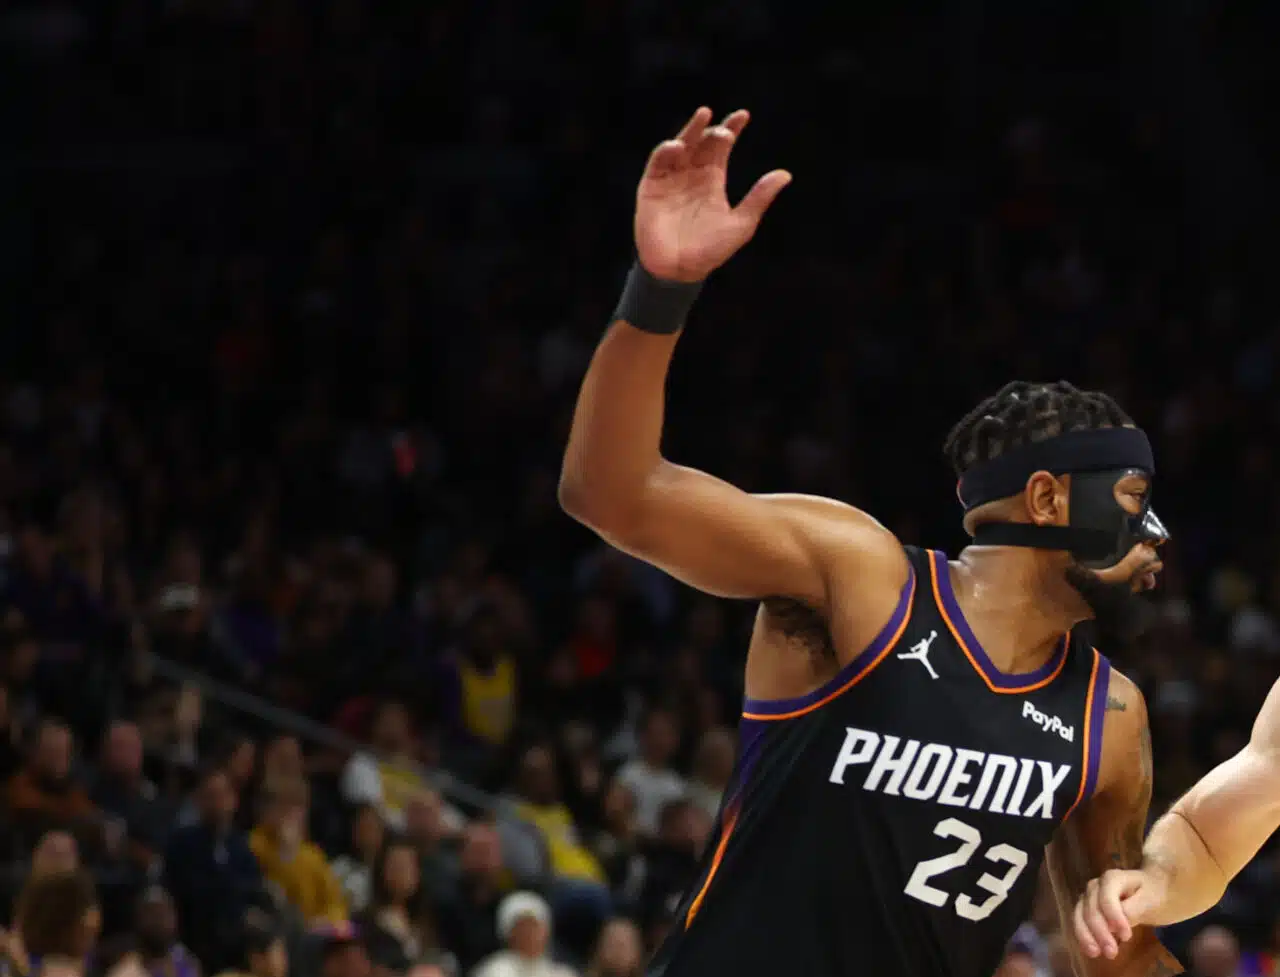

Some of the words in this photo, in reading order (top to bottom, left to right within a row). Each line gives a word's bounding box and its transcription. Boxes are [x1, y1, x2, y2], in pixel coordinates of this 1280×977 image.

[1022, 700, 1074, 742] PayPal
[828, 726, 1072, 819] PHOENIX
[903, 817, 1029, 922] 23
